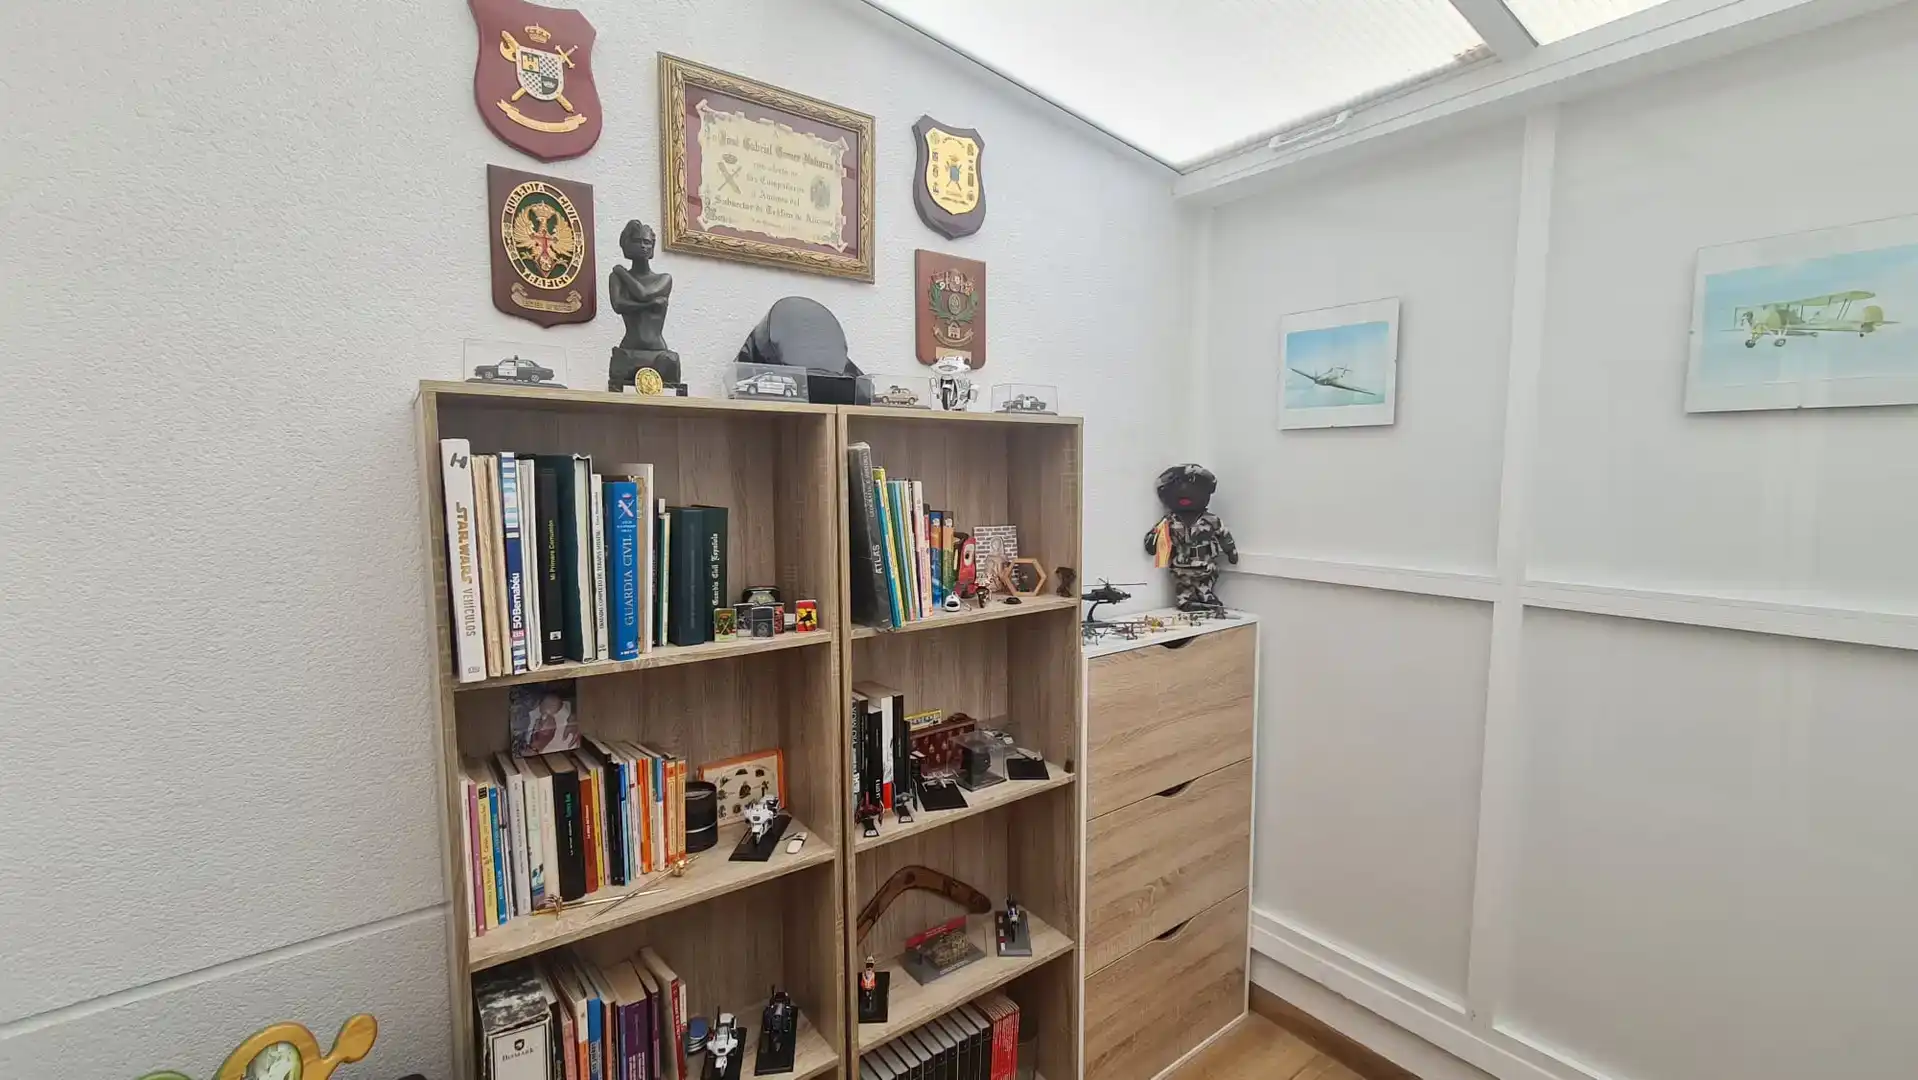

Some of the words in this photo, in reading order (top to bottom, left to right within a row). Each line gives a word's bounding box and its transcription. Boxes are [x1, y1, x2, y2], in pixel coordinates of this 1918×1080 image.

[743, 138, 772, 156] Gabriel
[505, 182, 546, 215] GUARDIA
[558, 195, 579, 222] CIVIL
[456, 501, 469, 543] STAR
[459, 542, 472, 584] WARS
[622, 534, 633, 567] CIVIL
[872, 544, 883, 574] ATLAS
[711, 564, 719, 579] Civil
[624, 568, 634, 626] GUARDIA
[711, 581, 719, 606] Guardia
[463, 587, 476, 637] VEHÍCULOS
